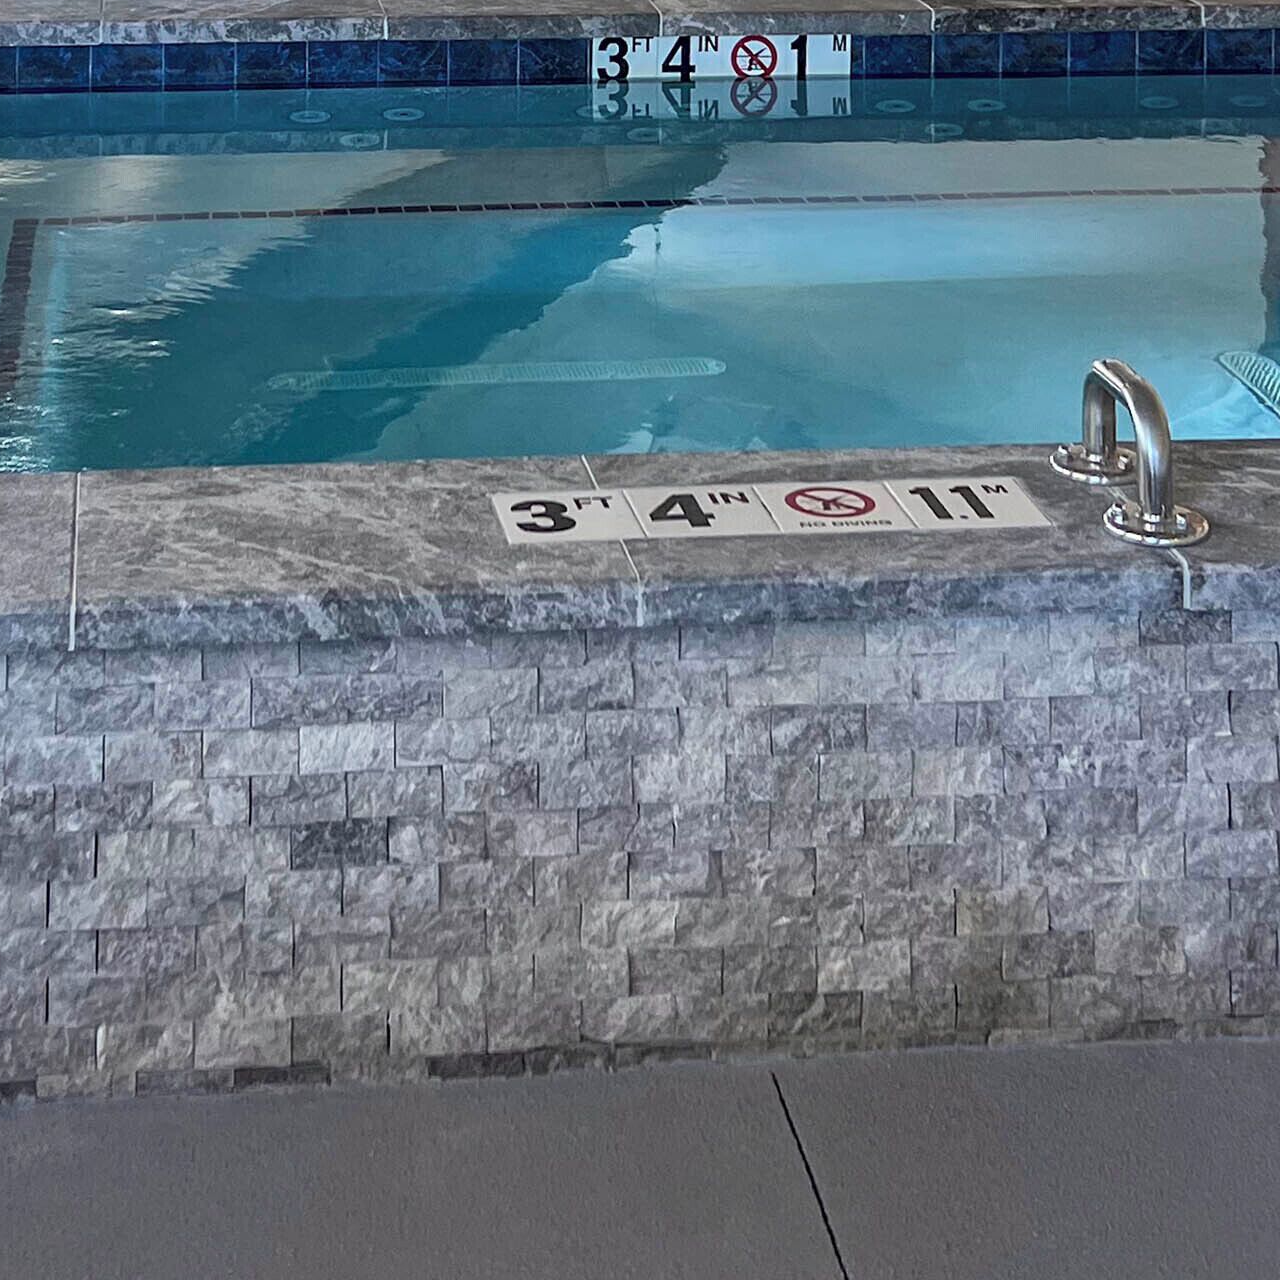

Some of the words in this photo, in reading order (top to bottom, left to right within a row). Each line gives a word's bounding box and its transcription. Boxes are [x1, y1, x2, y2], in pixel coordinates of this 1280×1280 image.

[597, 37, 629, 80] 3
[632, 36, 654, 53] FT
[662, 36, 696, 81] 4
[698, 35, 719, 52] IN
[790, 35, 807, 80] 1
[833, 35, 847, 51] M
[510, 500, 576, 533] 3
[573, 496, 612, 510] FT
[649, 493, 715, 528] 4
[708, 491, 749, 505] IN
[981, 484, 1008, 494] M
[799, 520, 826, 529] NO
[831, 519, 892, 528] DIVING
